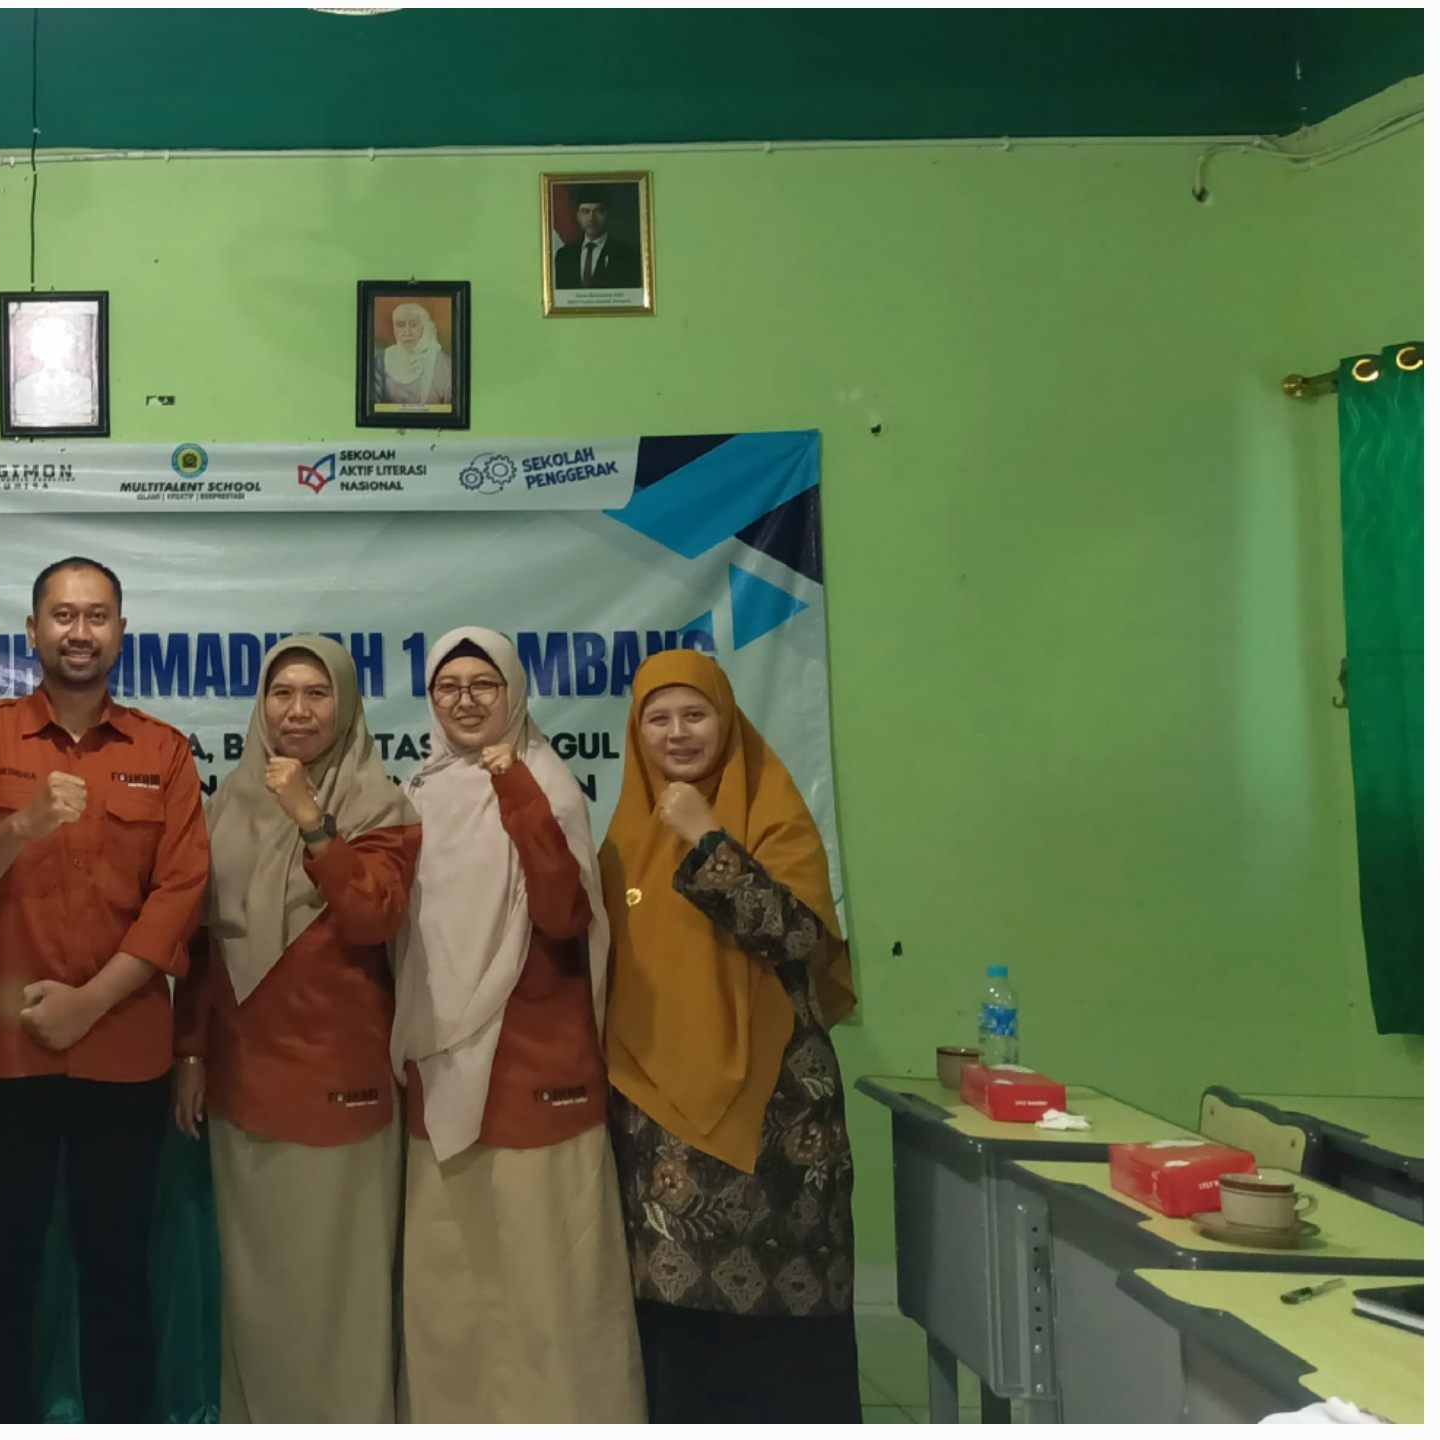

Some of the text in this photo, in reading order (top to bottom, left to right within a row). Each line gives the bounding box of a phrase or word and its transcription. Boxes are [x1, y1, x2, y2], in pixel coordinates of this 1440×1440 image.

[340, 450, 396, 461] SEKOLAH
[522, 447, 595, 473] SEKOLAH
[339, 464, 427, 476] AKTIF LITERASI
[525, 460, 618, 490] PENGGERAK
[120, 482, 262, 492] MULTITALENT SCHOOL
[340, 480, 404, 491] NASIONAL
[402, 632, 426, 697] 1
